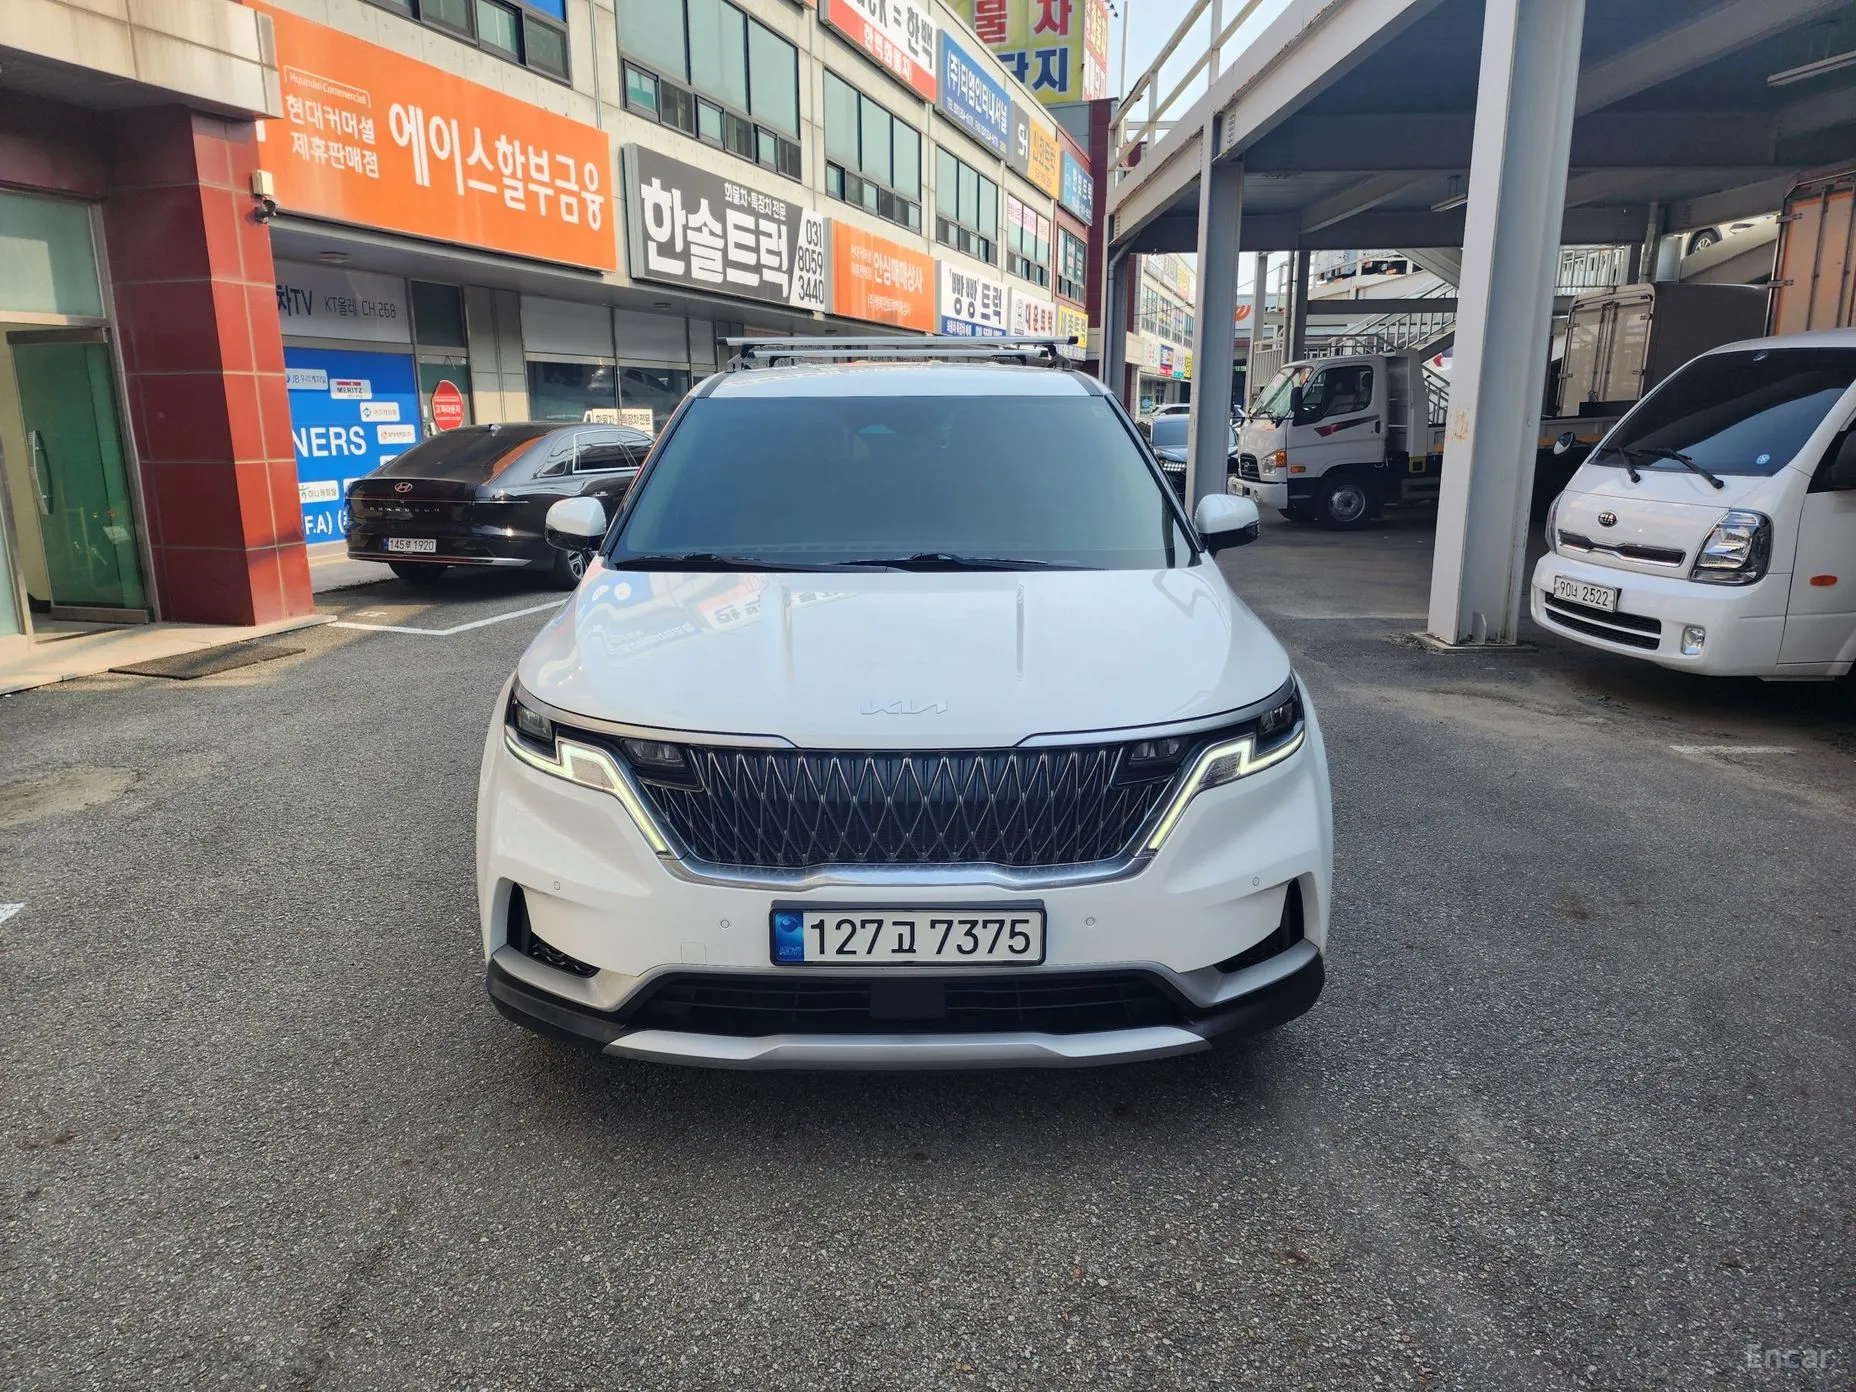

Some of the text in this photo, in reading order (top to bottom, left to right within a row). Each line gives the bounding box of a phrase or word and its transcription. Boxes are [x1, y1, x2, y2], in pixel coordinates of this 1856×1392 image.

[907, 5, 933, 70] 한백
[289, 71, 367, 104] Hyundai Commercial
[285, 93, 376, 145] 현대커머셜
[290, 131, 380, 179] 제휴판매점
[388, 102, 605, 231] 에이스할부금융
[772, 199, 787, 221] 전문
[641, 176, 789, 298] 한솔트럭
[806, 218, 822, 249] 031
[797, 246, 823, 275] 8059
[798, 275, 825, 305] 3440
[324, 296, 358, 317] KT올레
[361, 299, 397, 319] CH.268
[414, 540, 434, 551] 1920
[1582, 586, 1609, 607] 2522
[810, 919, 1031, 955] 127고 7375
